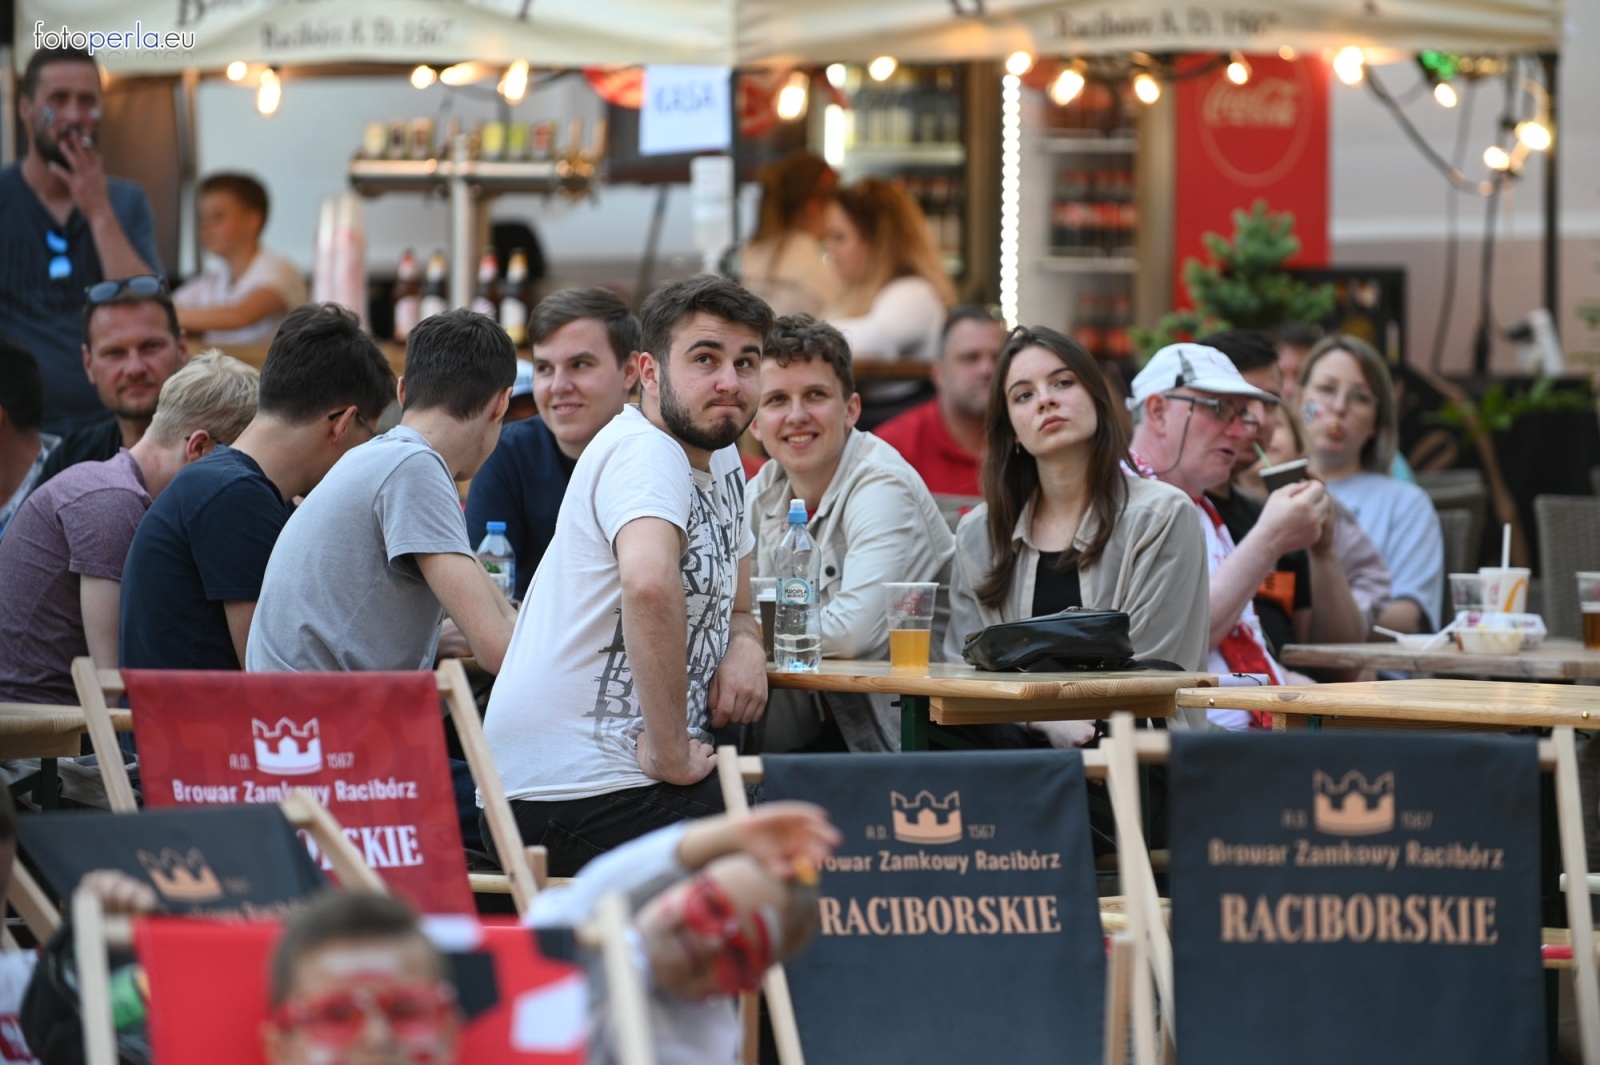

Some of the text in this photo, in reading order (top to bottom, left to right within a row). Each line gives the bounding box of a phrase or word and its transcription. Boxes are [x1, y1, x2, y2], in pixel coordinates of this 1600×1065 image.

[326, 752, 354, 769] 1567
[172, 779, 238, 803] Browar
[334, 777, 418, 802] Racibórz
[814, 849, 1062, 875] rowar Zamkowy Racibórz
[1207, 838, 1505, 872] Browar Zamkowy Racibórz
[818, 894, 1062, 937] RACIBORSKIE
[1220, 893, 1499, 946] RACIBORSKIE
